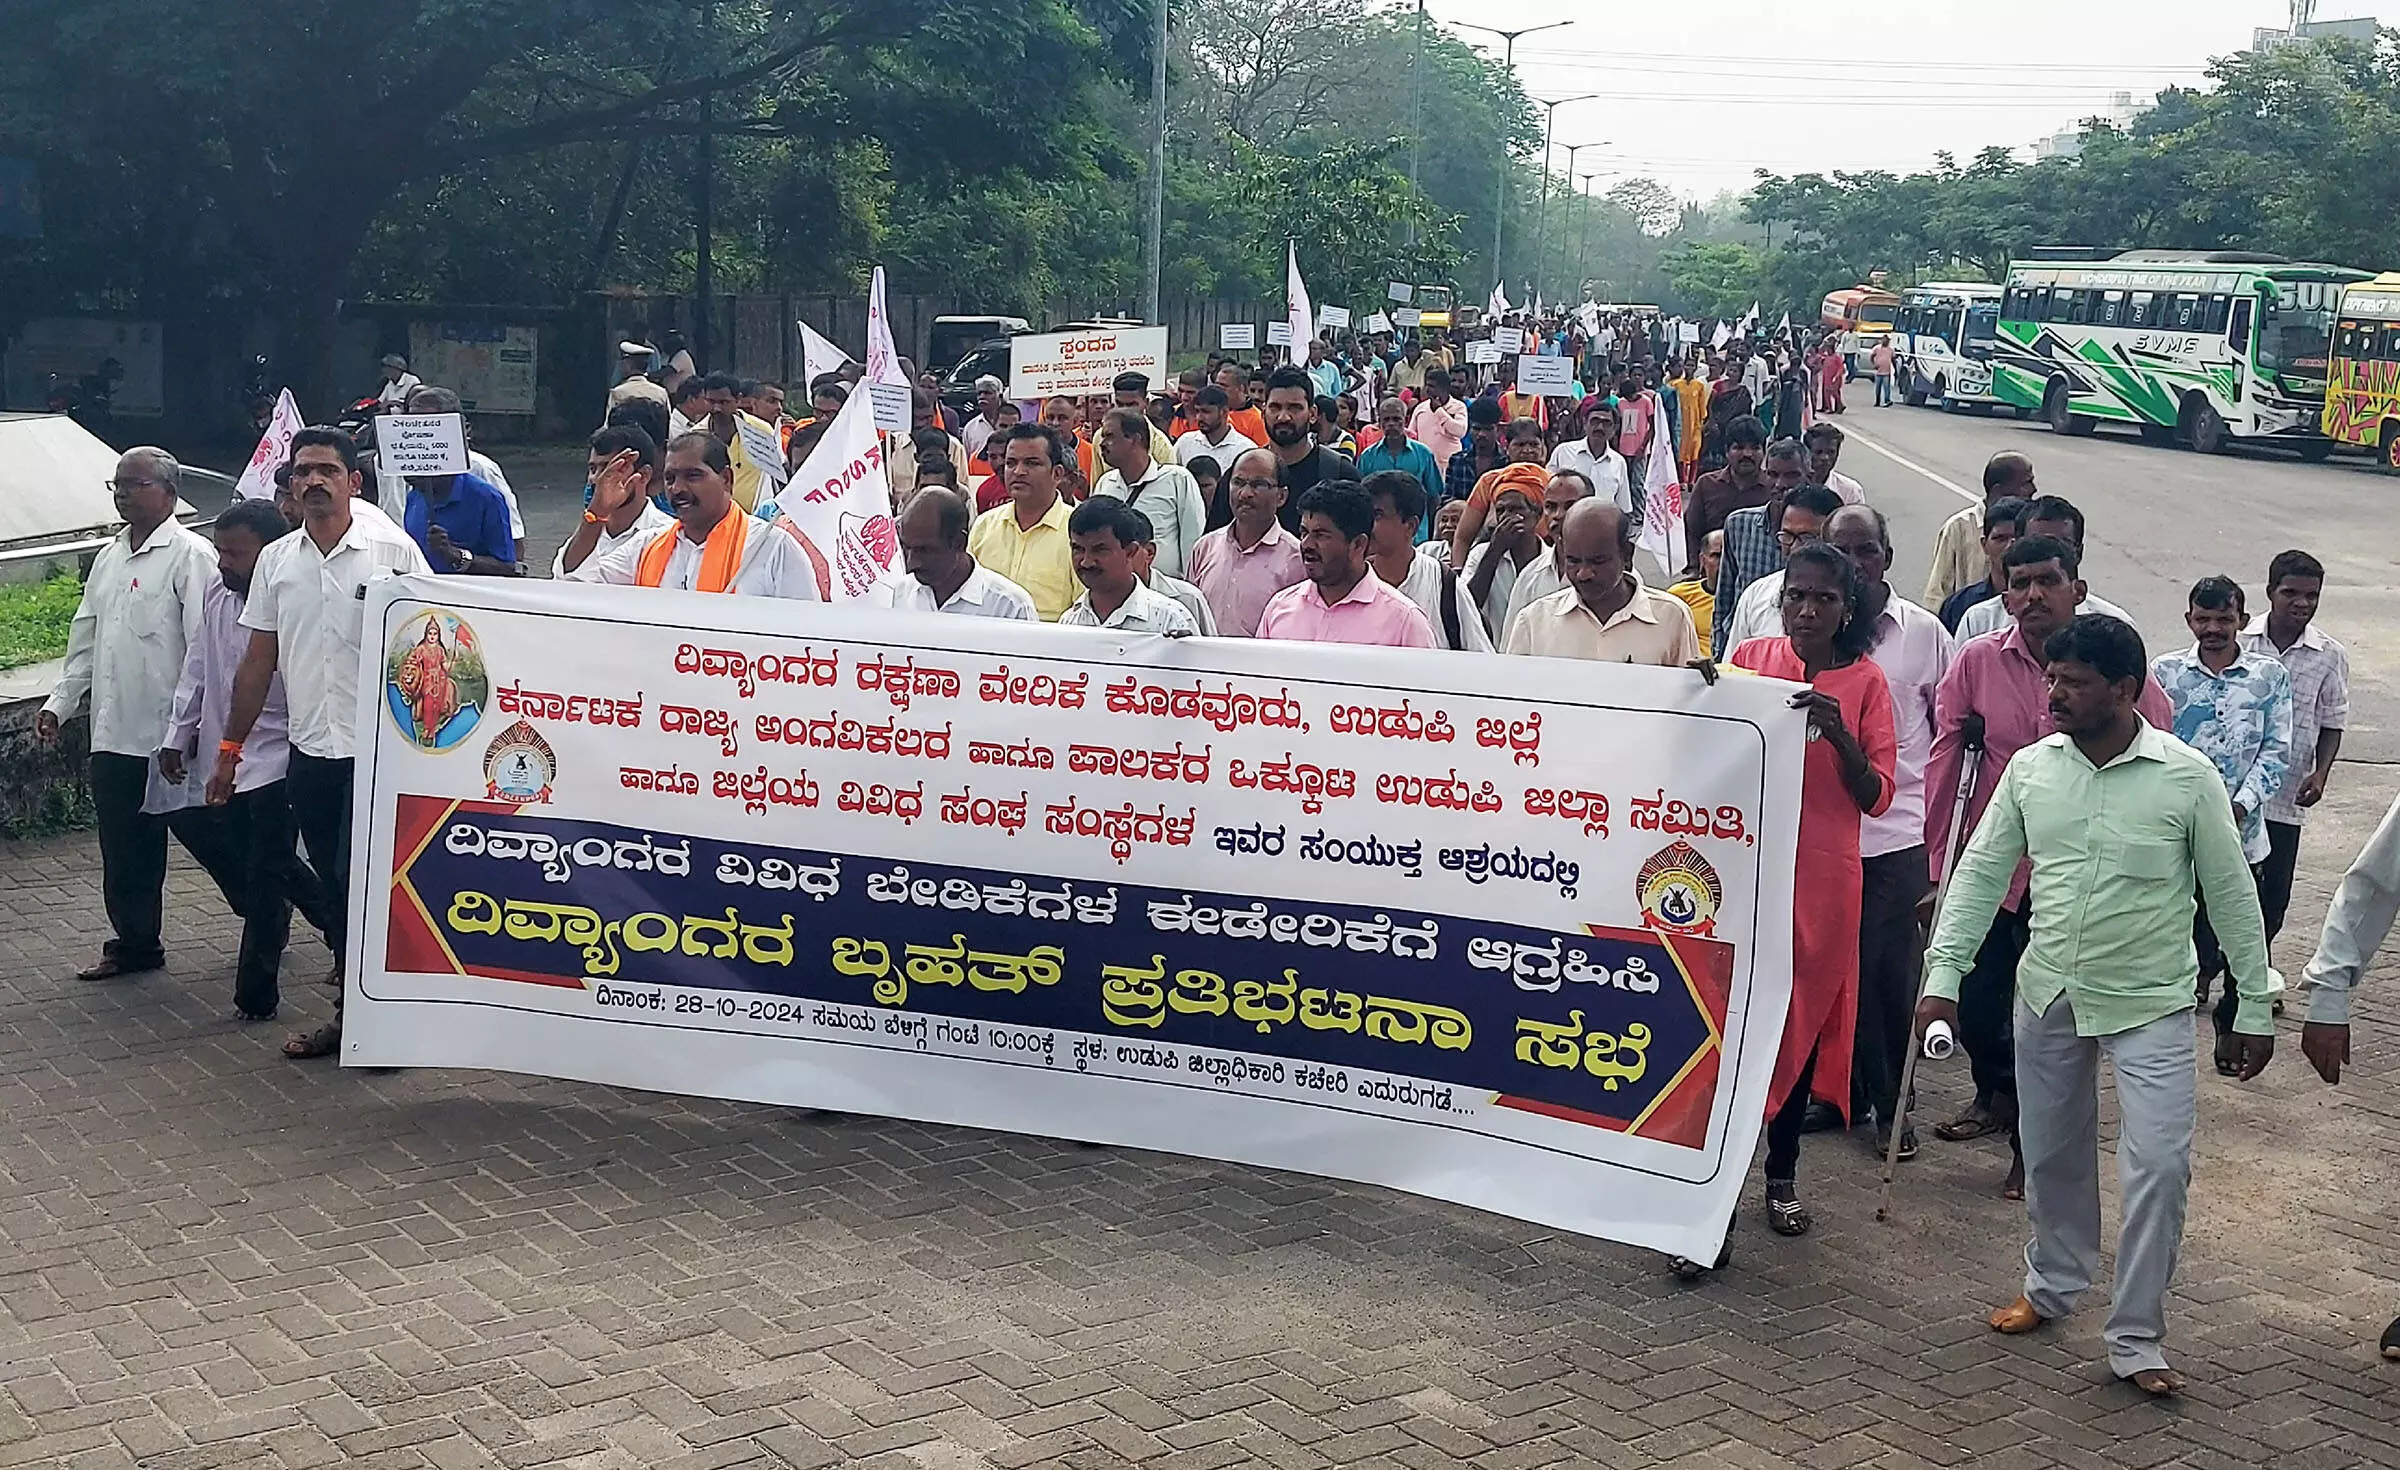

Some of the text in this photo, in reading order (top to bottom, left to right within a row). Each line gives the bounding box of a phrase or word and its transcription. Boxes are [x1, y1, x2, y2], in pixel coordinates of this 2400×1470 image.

[1060, 334, 1117, 360] ಸ್ಪಂದನ
[2135, 335, 2200, 354] SVMS
[674, 643, 1542, 768] ದಿವ್ಯಾಂಗರ ರಕ್ಷಣಾ ವೇದಿಕೆ ಕೊಡವೂರು, ಉಡುಪಿ ಜಿಲ್ಲೆ
[619, 765, 1580, 900] ಹಾಗೂ ಜಿಲ್ಲೆಯ ವಿವಿಧ ಸಂಘ ಸಂಸ್ಥೆಗಳ ಇವರ ಸಂಯುಕ್ತ ಆಶ್ರಯದಲ್ಲಿ
[659, 704, 739, 757] ರಾಜ್ಯ
[755, 710, 952, 760] ಅಂಗವಿಕಲರ
[968, 741, 1054, 770] ಹಾಗೂ
[1068, 741, 1211, 784] ಪಾಲಕರ
[1229, 751, 1357, 815] ಒಕ್ಕೂಟ
[1375, 768, 1503, 814] ಉಡುಪಿ
[1524, 788, 1610, 839] ಜಿಲ್ಲಾ
[1630, 788, 1754, 848] ಸಮಿತಿ,
[445, 824, 1660, 994] ದಿವ್ಯಾಂಗರ ವಿವಿಧ ಬೇಡಿಕೆಗಳ ಈಡೇರಿಕೆಗೆ ಆಗ್ರಹಿಸಿ
[447, 890, 1652, 1091] ದಿವ್ಯಾಂಗರ ಬೃಹತ್ ಪ್ರತಿಭಟನಾ ಸಭೆ
[596, 984, 666, 1010] ದಿನಾಂಕ:
[674, 994, 805, 1024] 28-10-2024
[812, 1004, 876, 1032] ಸಮಯ
[936, 1019, 980, 1045] ಗಂಟೆ
[1073, 1036, 1108, 1074] ಸ್ಥಳ:
[1116, 1043, 1179, 1070] ಉಡುಪಿ
[1188, 1054, 1285, 1087] ಜಿಲ್ಲಾಧಿಕಾರಿ
[1294, 1064, 1349, 1094] ಕಚೇರಿ
